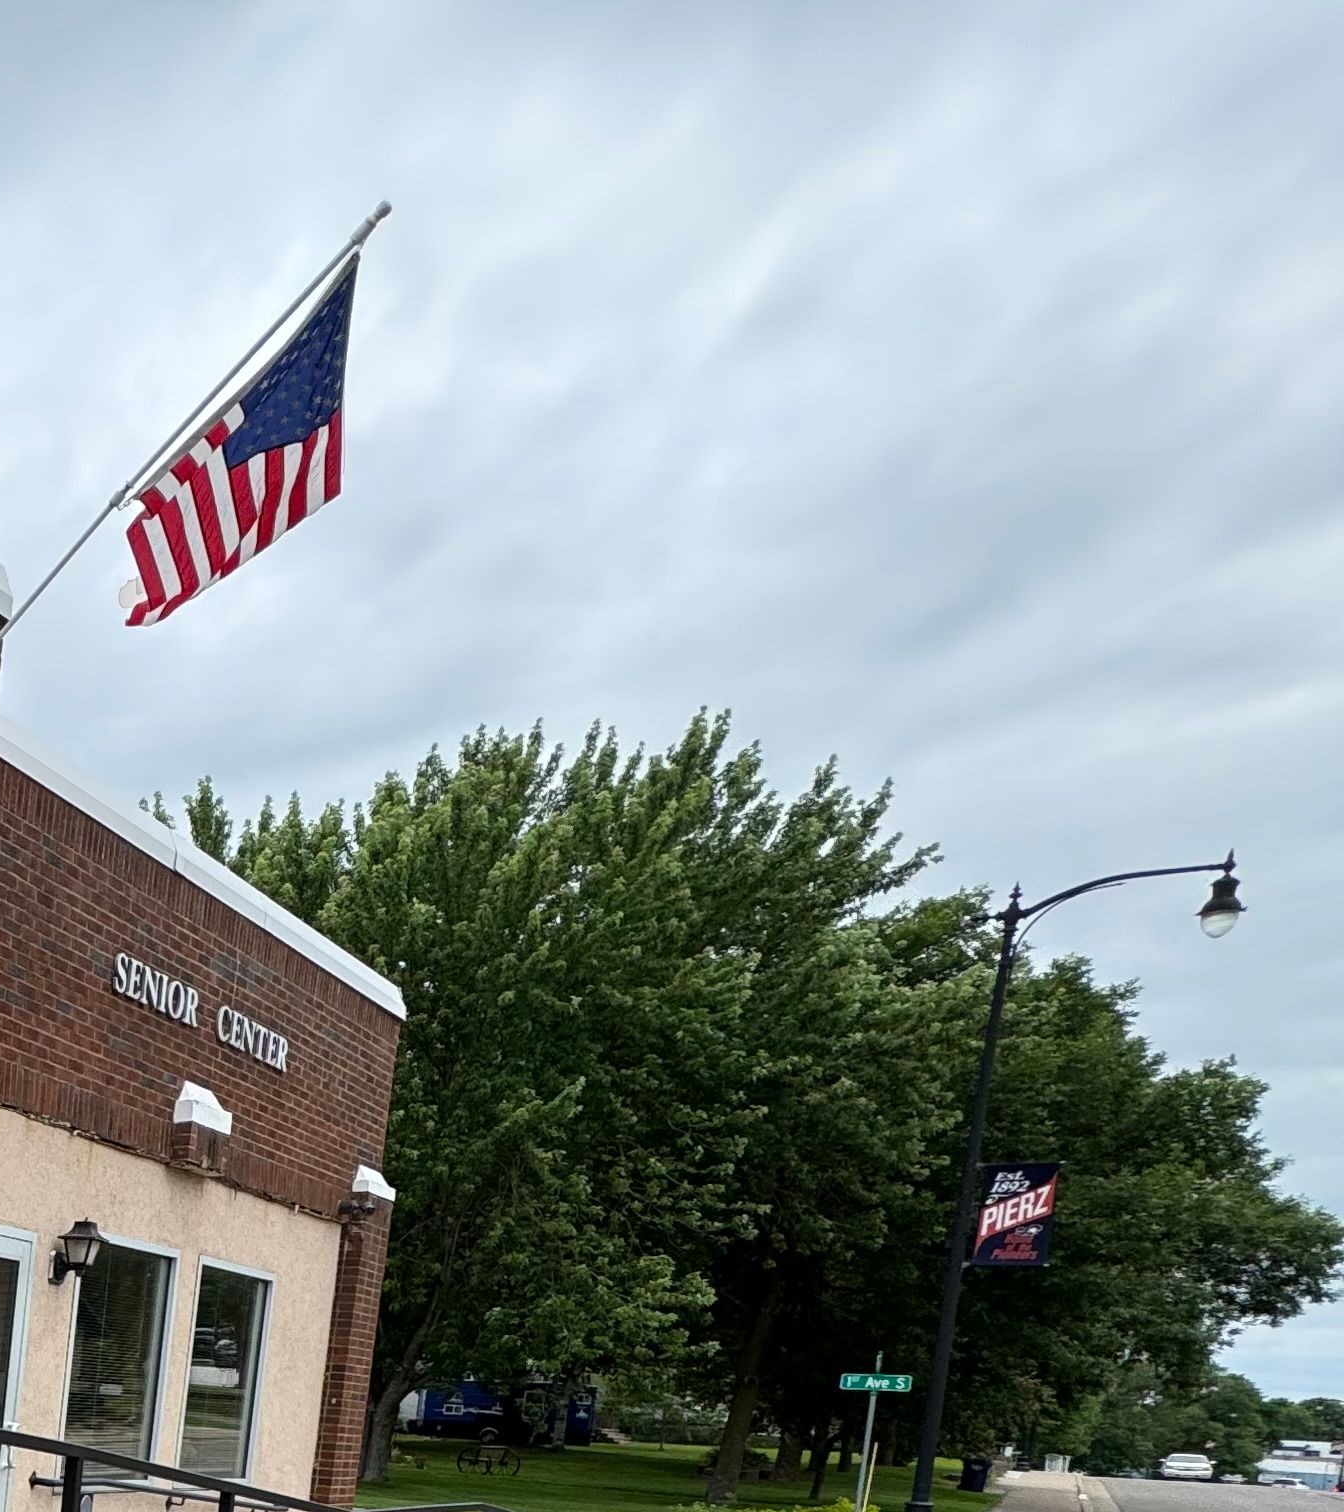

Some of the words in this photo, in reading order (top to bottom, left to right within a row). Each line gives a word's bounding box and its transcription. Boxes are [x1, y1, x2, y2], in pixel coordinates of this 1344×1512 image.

[112, 952, 199, 1028] SENIOR
[215, 1005, 290, 1073] CENTER
[989, 1180, 1032, 1193] 1892
[980, 1184, 1052, 1237] PIERZ
[864, 1376, 891, 1389] Ave
[894, 1377, 906, 1390] S
